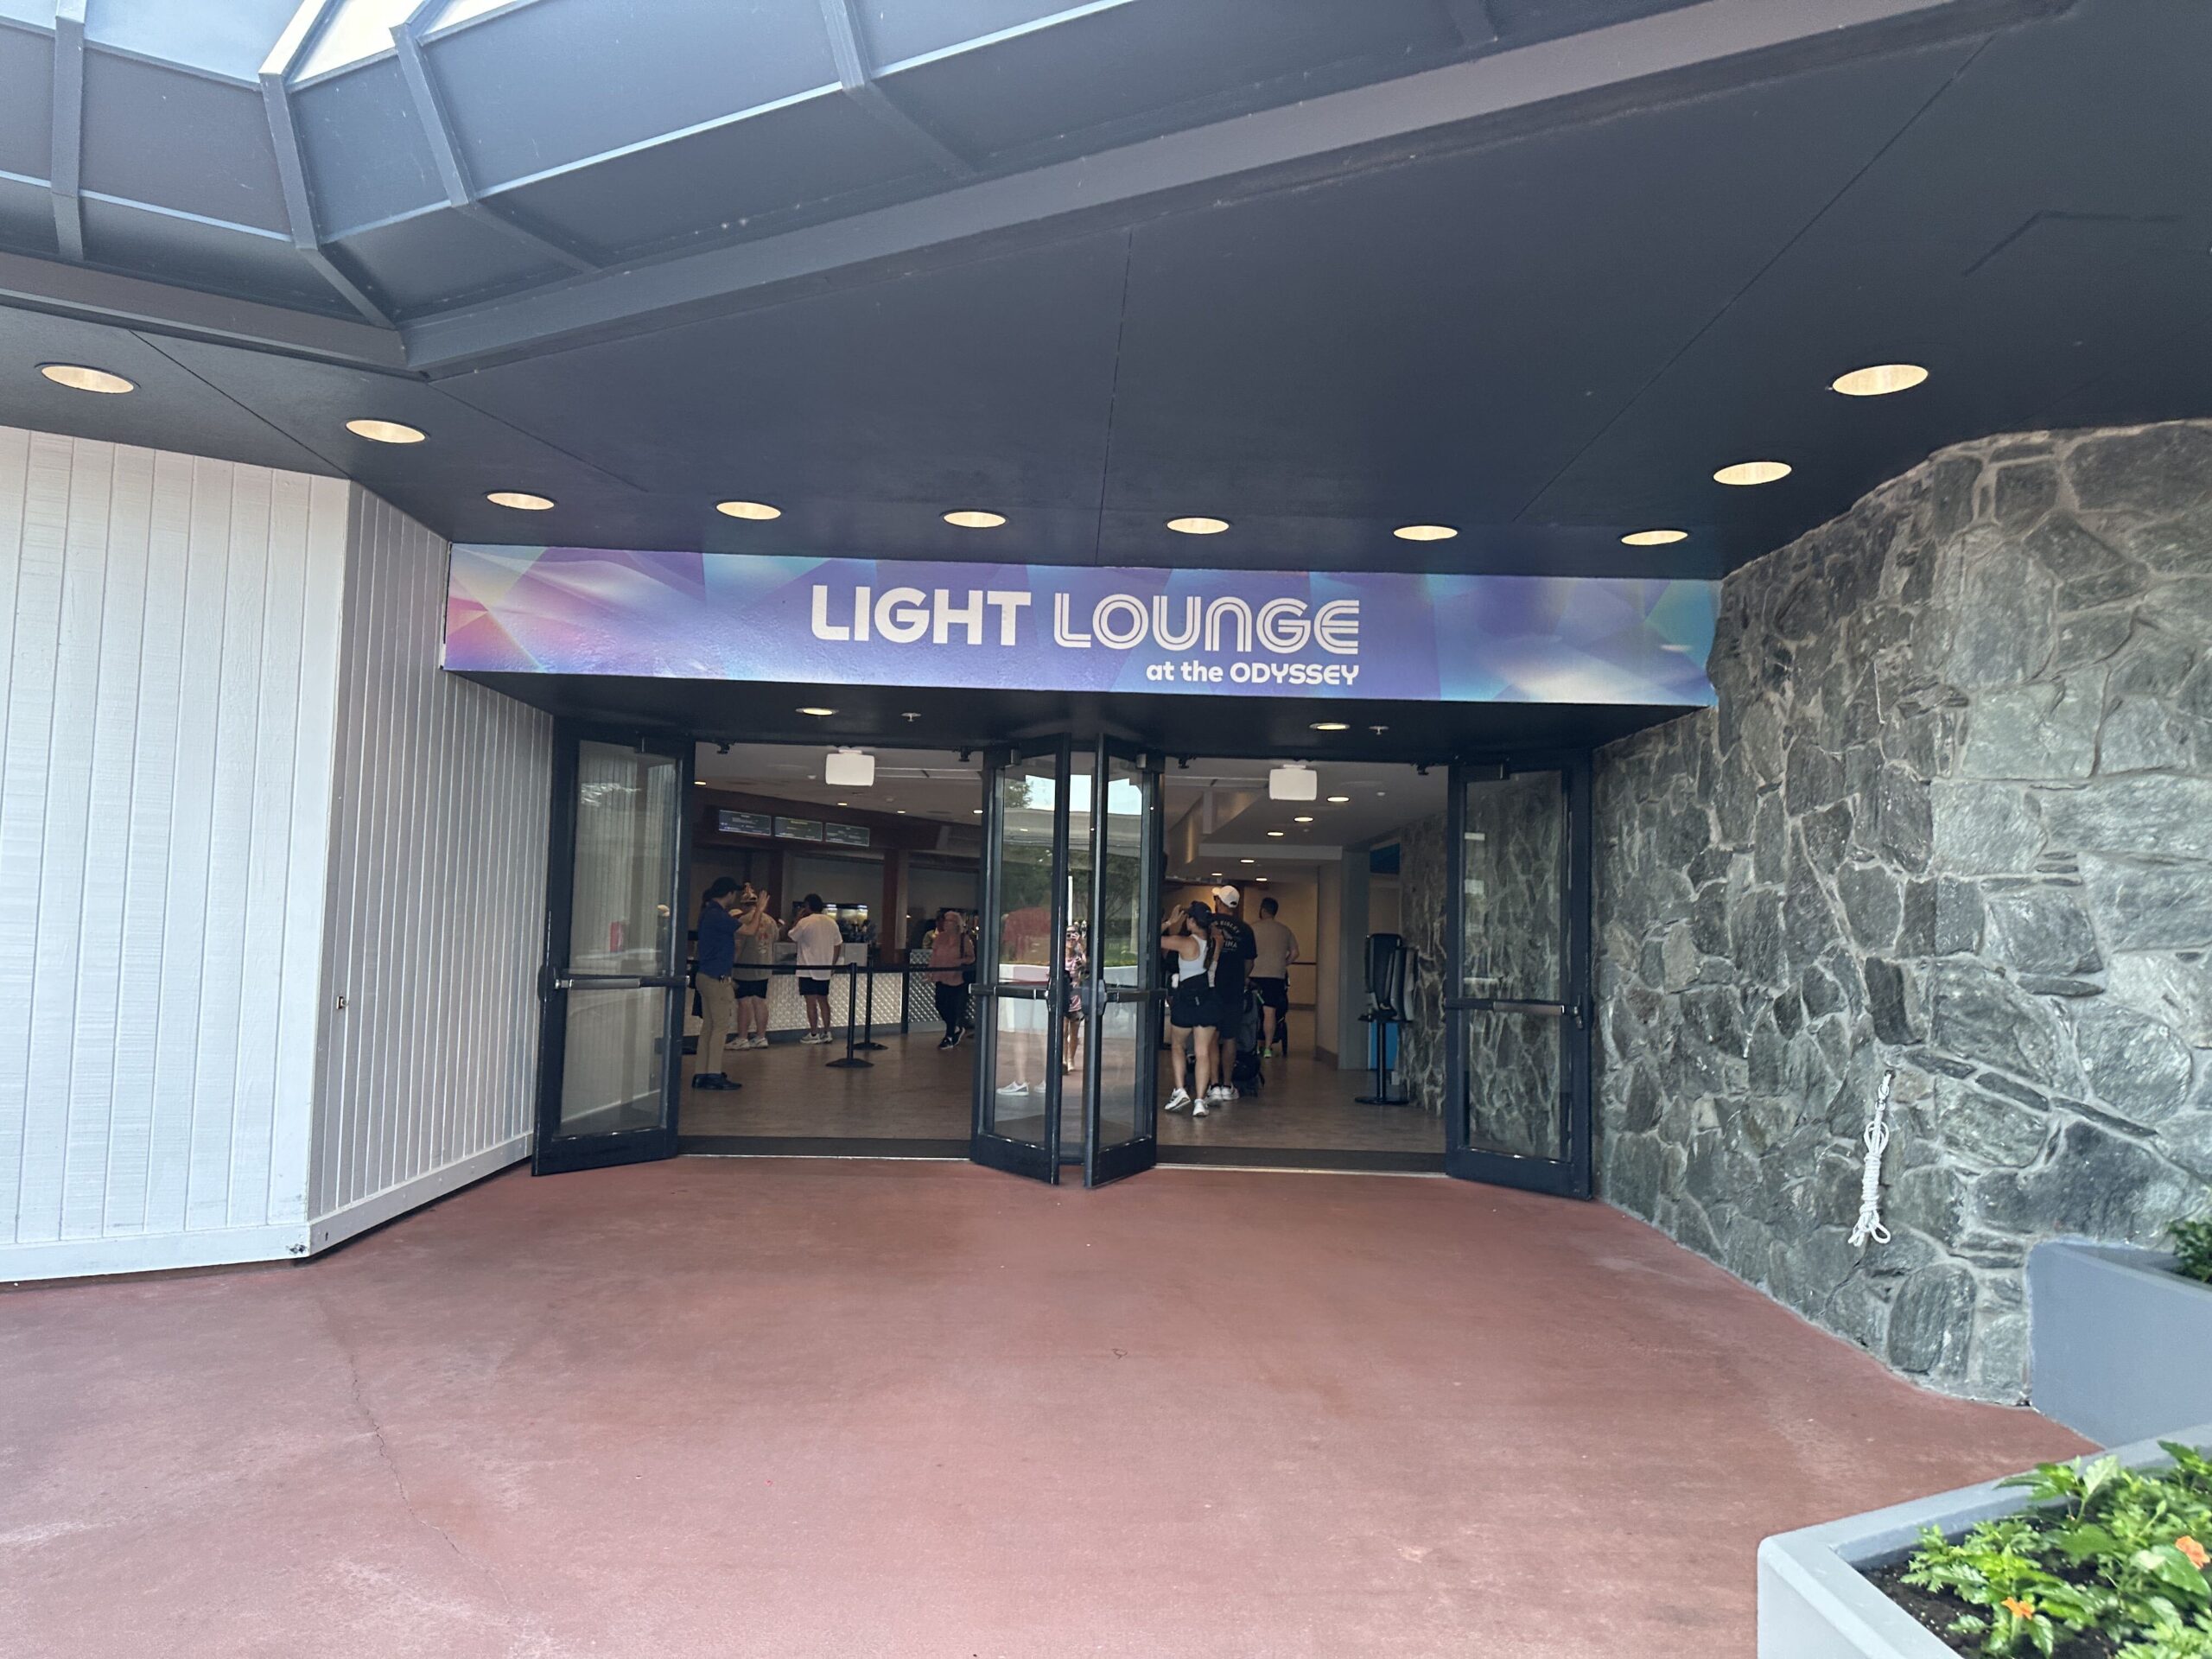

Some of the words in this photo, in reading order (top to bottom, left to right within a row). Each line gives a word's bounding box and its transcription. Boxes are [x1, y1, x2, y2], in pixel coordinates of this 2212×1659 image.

[810, 584, 1032, 646] LIGHT
[1052, 592, 1360, 656] LOUNGE
[1145, 660, 1175, 682] at
[1179, 658, 1224, 683] the
[1229, 661, 1360, 686] ODYSSEY
